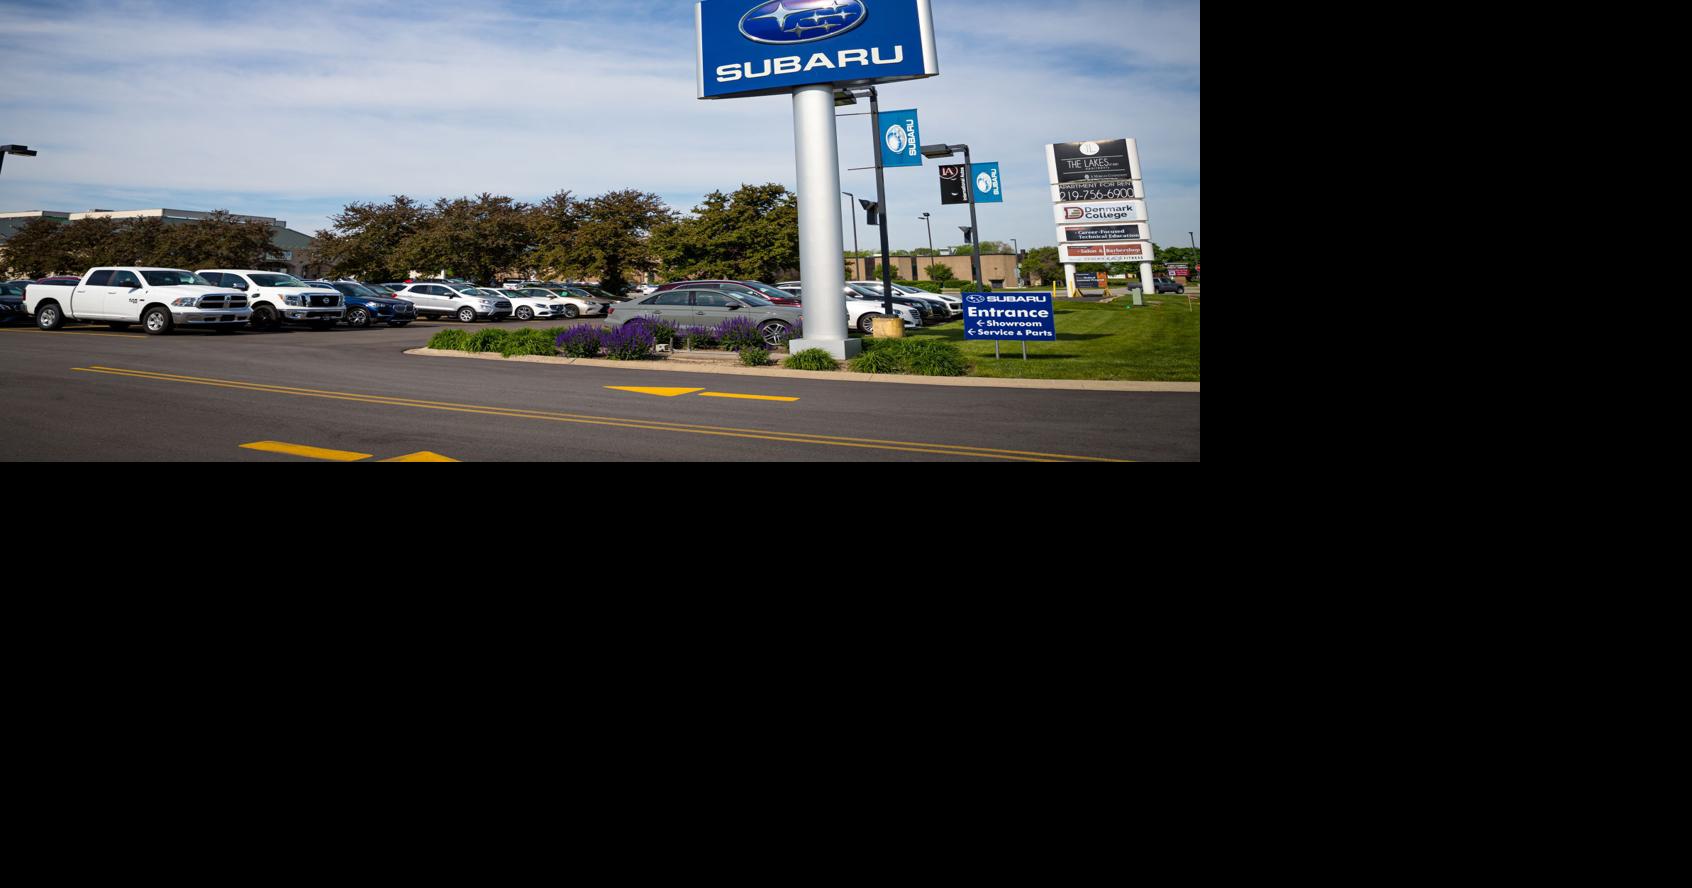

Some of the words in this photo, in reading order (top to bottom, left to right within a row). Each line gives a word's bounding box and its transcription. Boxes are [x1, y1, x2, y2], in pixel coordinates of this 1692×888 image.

[716, 45, 904, 82] SUBARU
[906, 119, 916, 156] SUBARU
[1067, 160, 1082, 168] THE
[1084, 158, 1109, 167] LAKES
[991, 169, 999, 195] SUBARU
[1060, 188, 1134, 200] 219-756-6900
[967, 306, 1049, 318] Entrance
[986, 319, 1042, 327] Showroom
[977, 328, 1014, 336] Service
[1025, 329, 1053, 337] Parts
